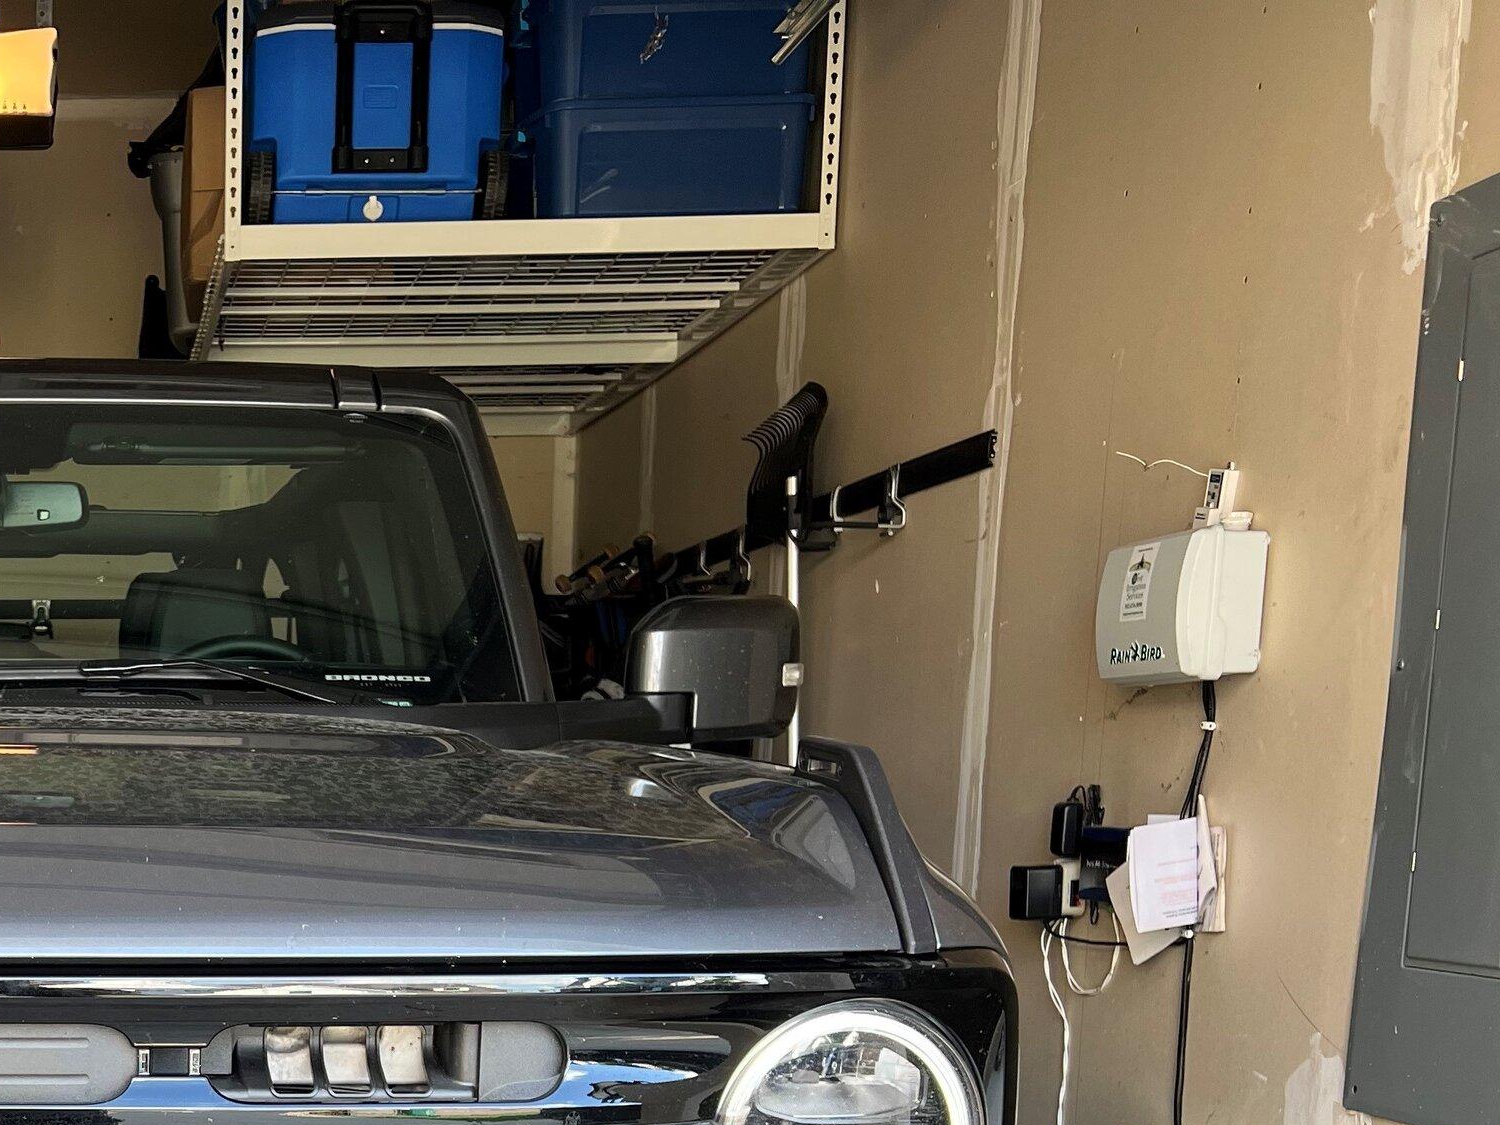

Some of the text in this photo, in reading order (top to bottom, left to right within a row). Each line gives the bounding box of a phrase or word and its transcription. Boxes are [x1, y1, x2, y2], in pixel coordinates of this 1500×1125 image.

[1110, 644, 1162, 665] RAIN BIRD
[324, 674, 431, 682] BRONCO
